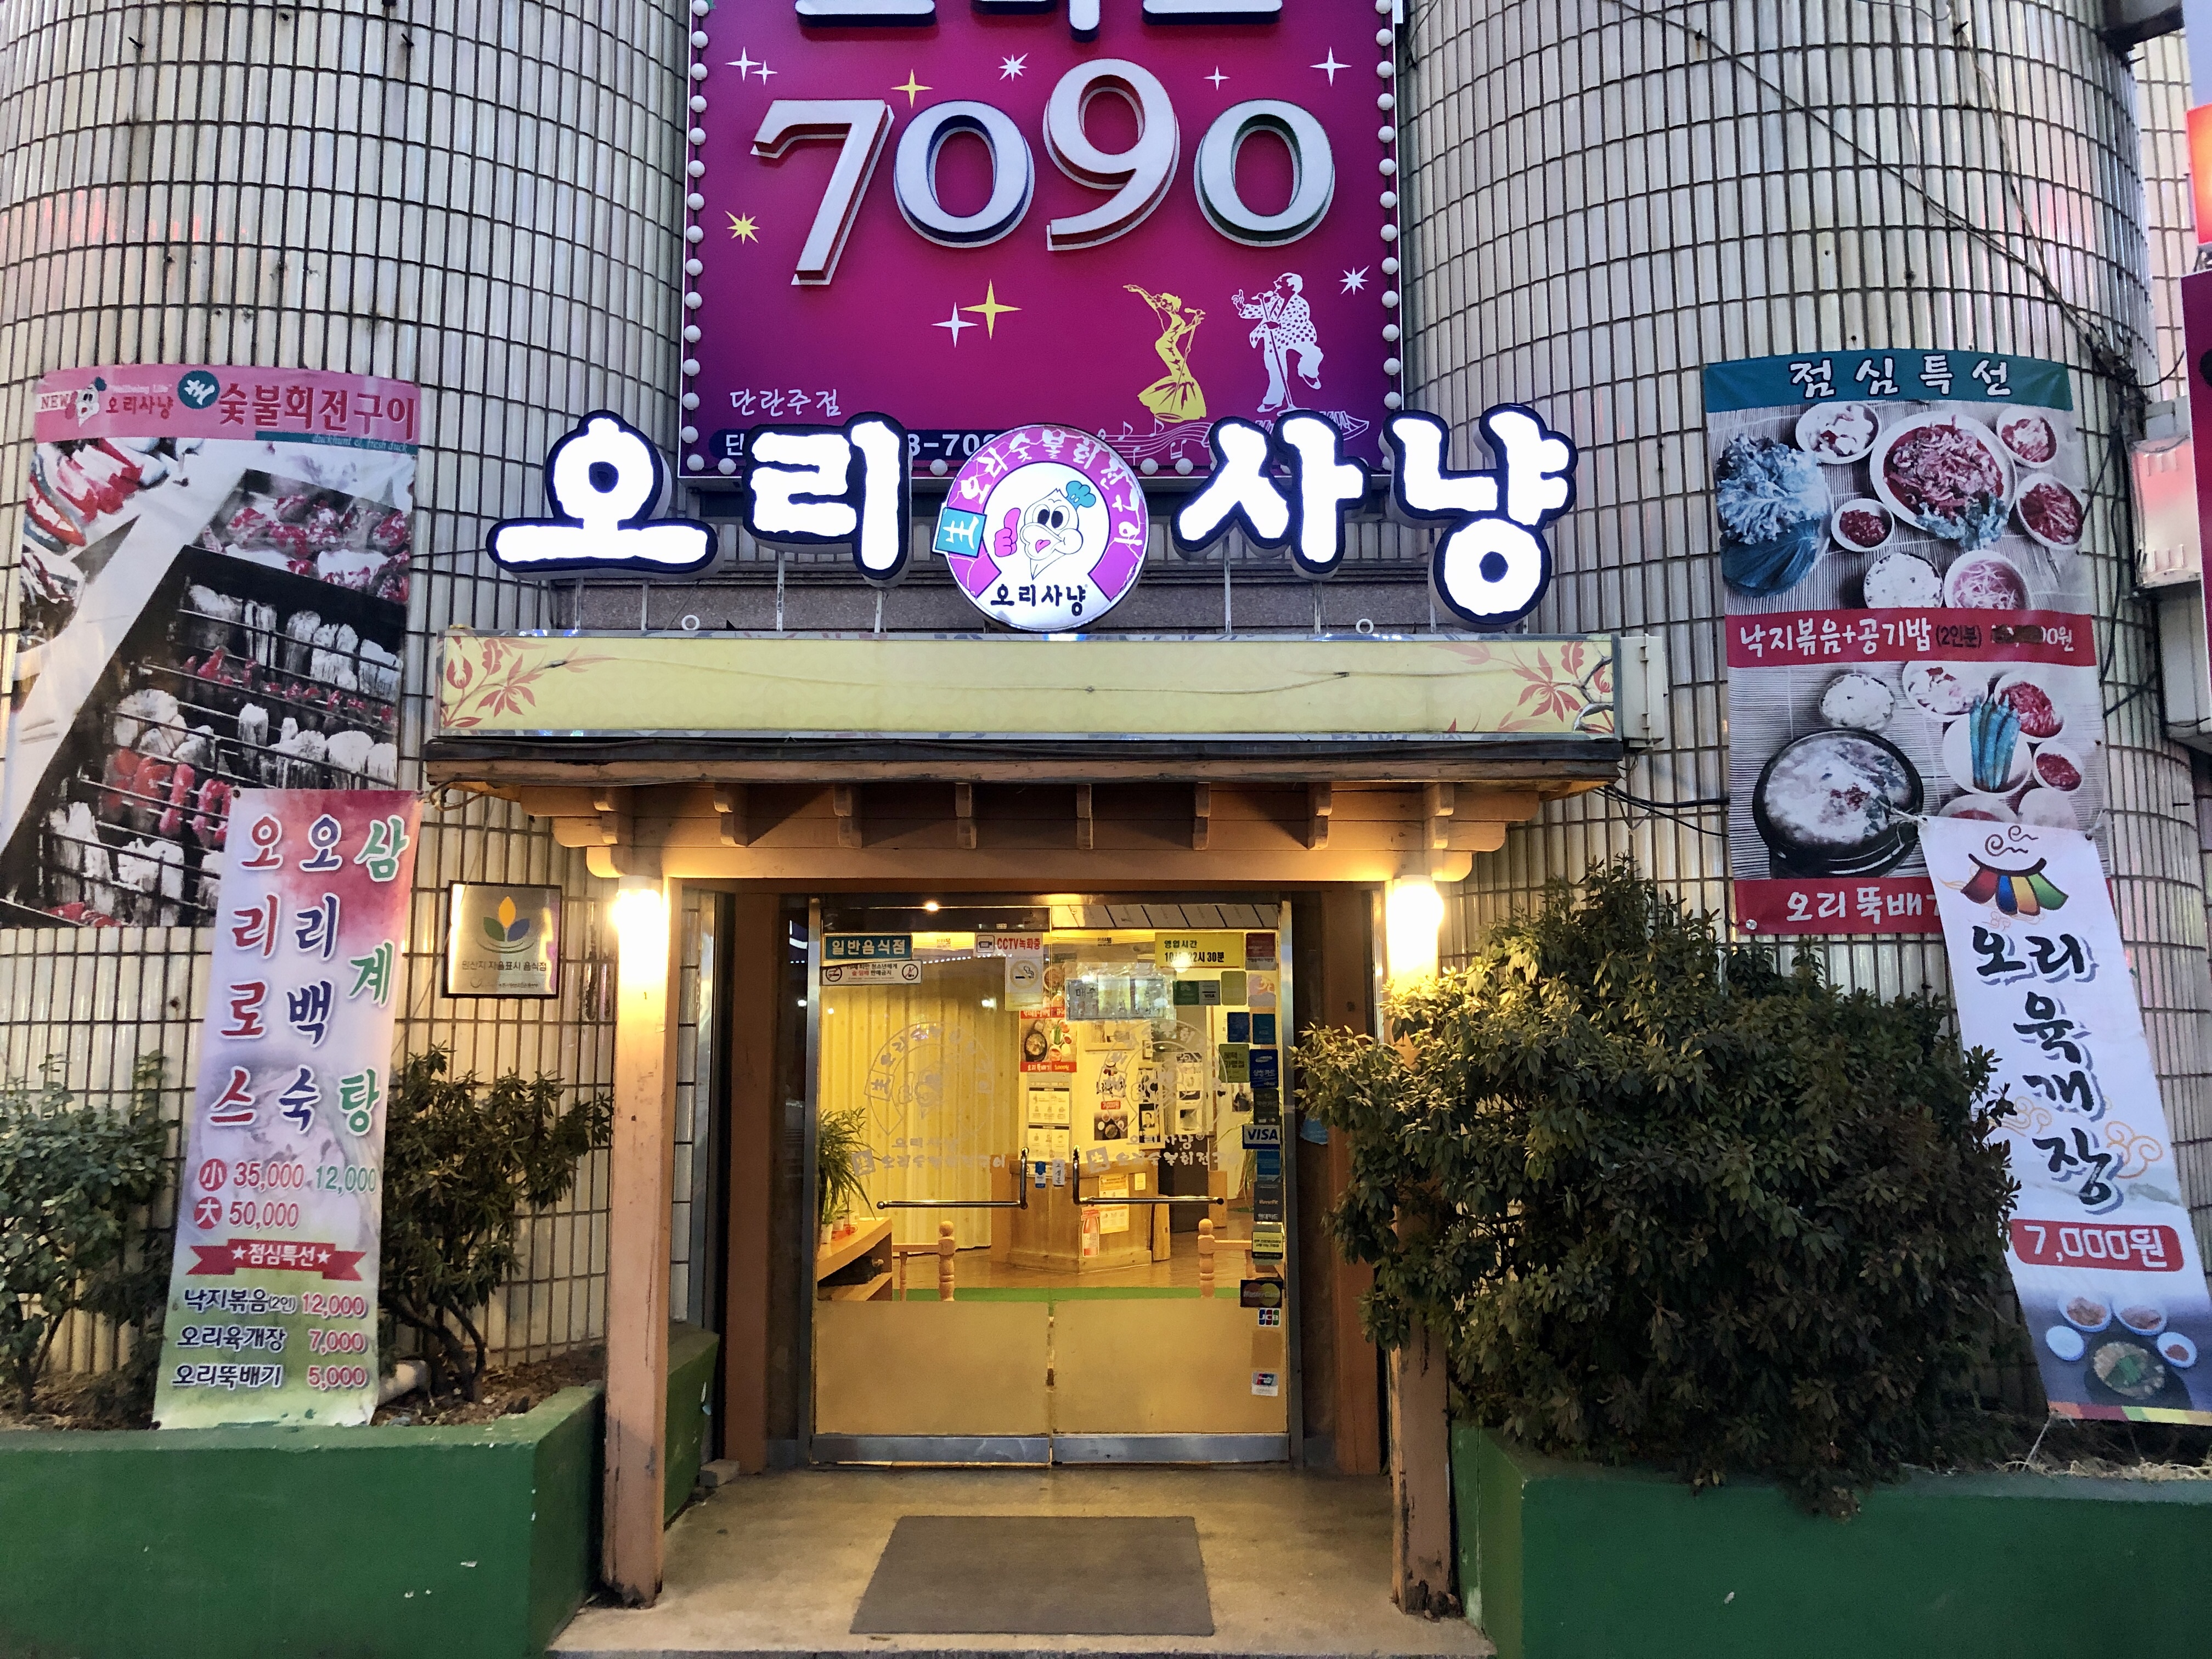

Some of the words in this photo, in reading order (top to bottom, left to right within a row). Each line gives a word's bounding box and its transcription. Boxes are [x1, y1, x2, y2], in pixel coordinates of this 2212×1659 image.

[749, 57, 1336, 286] 7090
[1790, 353, 2011, 399] 점심특선
[40, 396, 71, 409] NEW
[106, 396, 174, 420] 오리사냥
[219, 383, 415, 441] 숯불회전구이
[729, 388, 842, 417] 단란주점
[367, 439, 387, 450] fresh
[388, 441, 408, 453] duck
[960, 428, 1143, 546] 오리숯불회전구이
[488, 411, 909, 585] 오리
[1172, 404, 1575, 624] 사냥
[990, 583, 1086, 617] 오리사냥
[1740, 617, 1932, 658] 낙지볶음+공기밥
[1935, 624, 1982, 648] (2인분)
[1786, 891, 1846, 922] 오리
[832, 939, 905, 955] 일반음식점
[997, 937, 1041, 950] CCTV녹화중
[1164, 940, 1198, 949] 영업시간
[1207, 951, 1224, 963] 30분
[1972, 924, 2086, 978] 오리
[209, 815, 281, 1125] 오리로스
[278, 815, 342, 1132] 오리백숙
[339, 816, 409, 1133] 삼계탕
[462, 961, 486, 970] 원산지
[488, 961, 521, 970] 자율표시
[523, 961, 546, 971] 음식점
[2013, 991, 2112, 1206] 육개장
[1248, 1128, 1278, 1141] VISA
[233, 1161, 305, 1191] 35,000
[315, 1165, 377, 1194] 12,000
[228, 1200, 300, 1231] 50,000
[249, 1243, 315, 1267] 점심특선
[2024, 1224, 2168, 1268] 7,000원
[184, 1288, 296, 1313] 낙지볶음(2인)
[302, 1293, 366, 1318] 12,000
[177, 1326, 286, 1352] 오리육개장
[308, 1330, 365, 1354] 7,000
[172, 1364, 282, 1390] 오리뚝배기
[308, 1365, 366, 1390] 5,000
